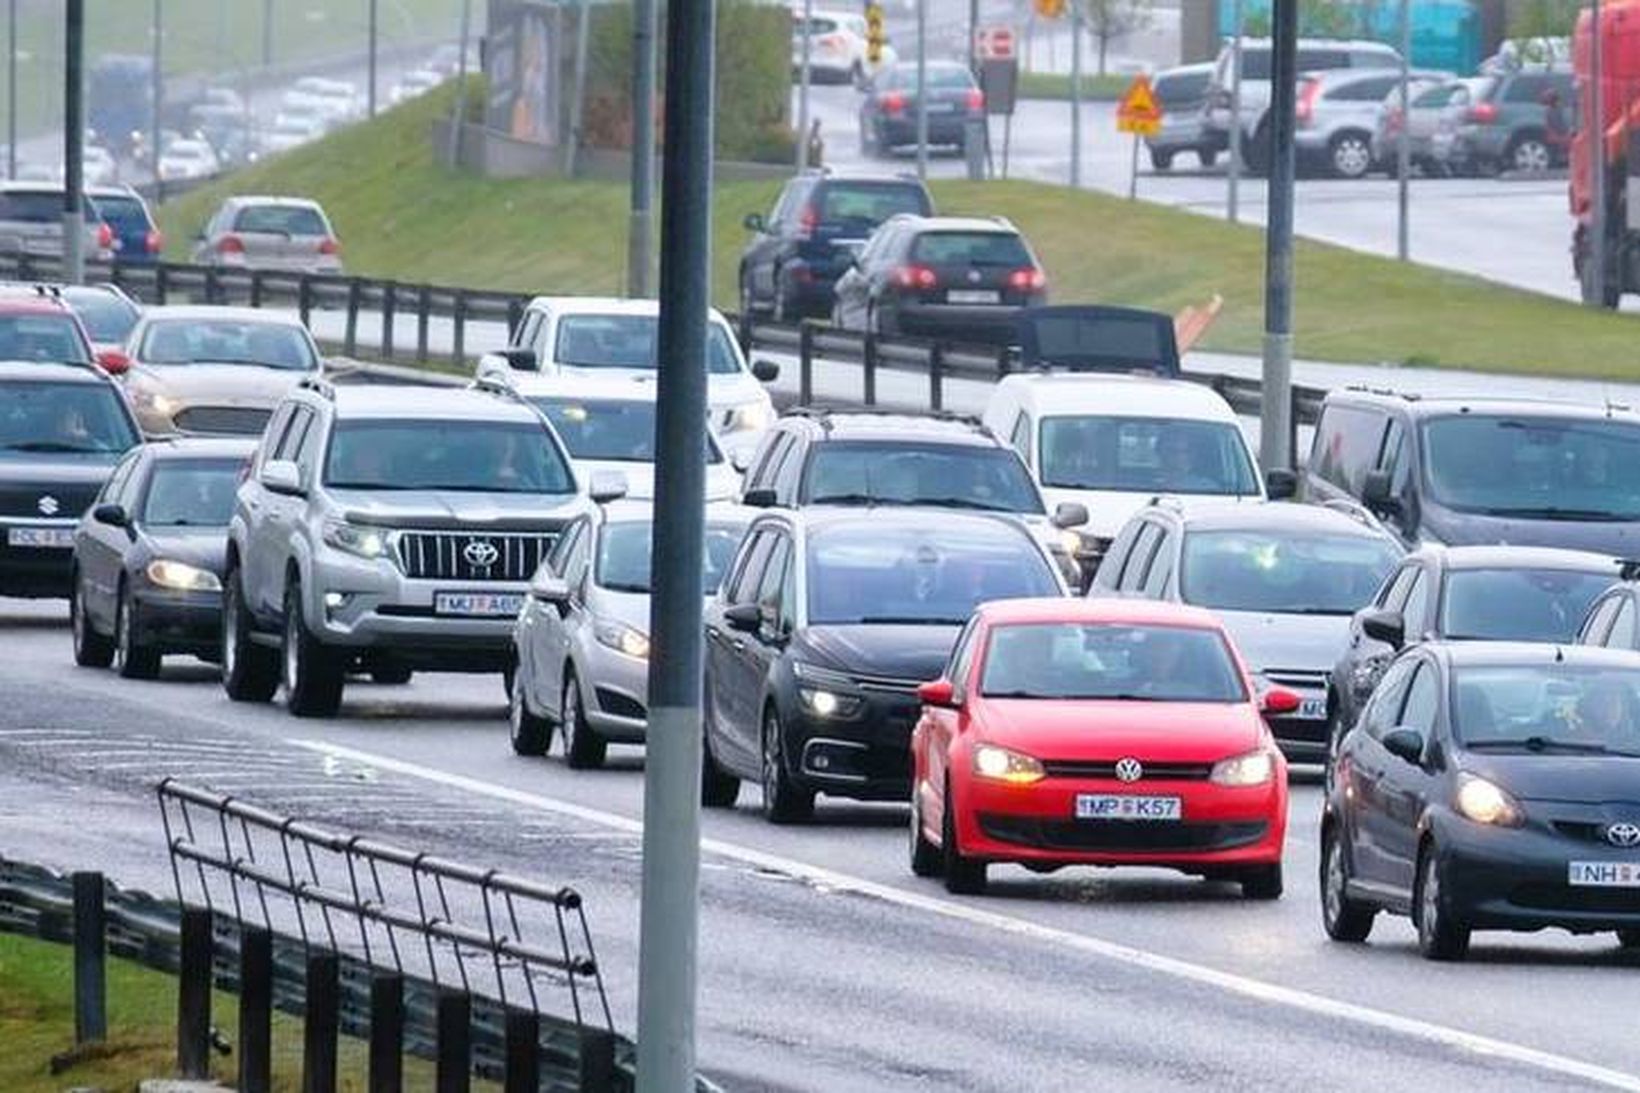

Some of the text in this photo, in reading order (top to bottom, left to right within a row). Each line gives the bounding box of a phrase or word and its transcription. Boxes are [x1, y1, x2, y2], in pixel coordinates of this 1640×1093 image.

[1089, 799, 1177, 816] MP K57
[1585, 865, 1617, 882] NH
